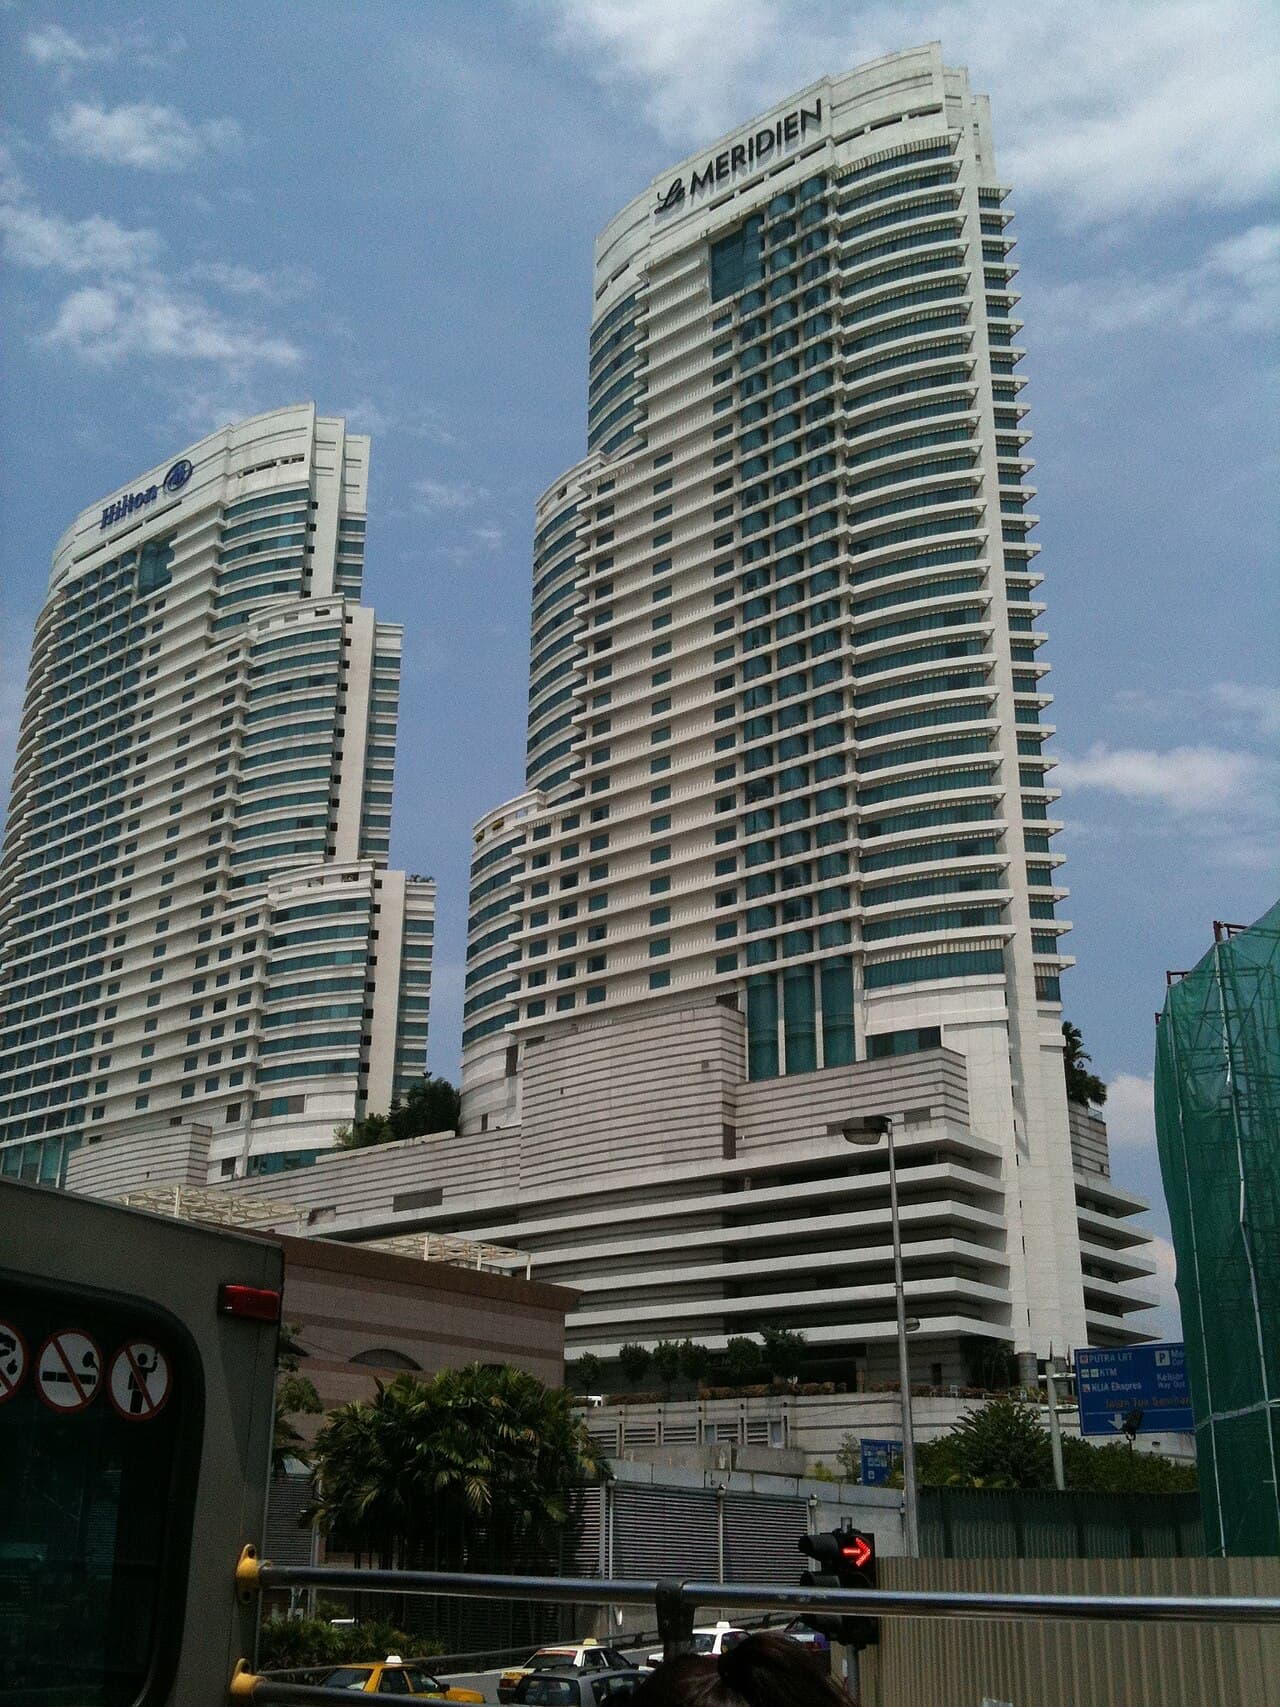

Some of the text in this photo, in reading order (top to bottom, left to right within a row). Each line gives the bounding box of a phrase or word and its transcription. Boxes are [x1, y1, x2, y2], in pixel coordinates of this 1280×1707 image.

[655, 98, 821, 214] Le MERIDIEN
[100, 485, 157, 529] Hilton
[1089, 1351, 1133, 1363] PUTRA LRT
[1100, 1367, 1117, 1377] KTM
[1091, 1381, 1142, 1392] KLIA Ekspres
